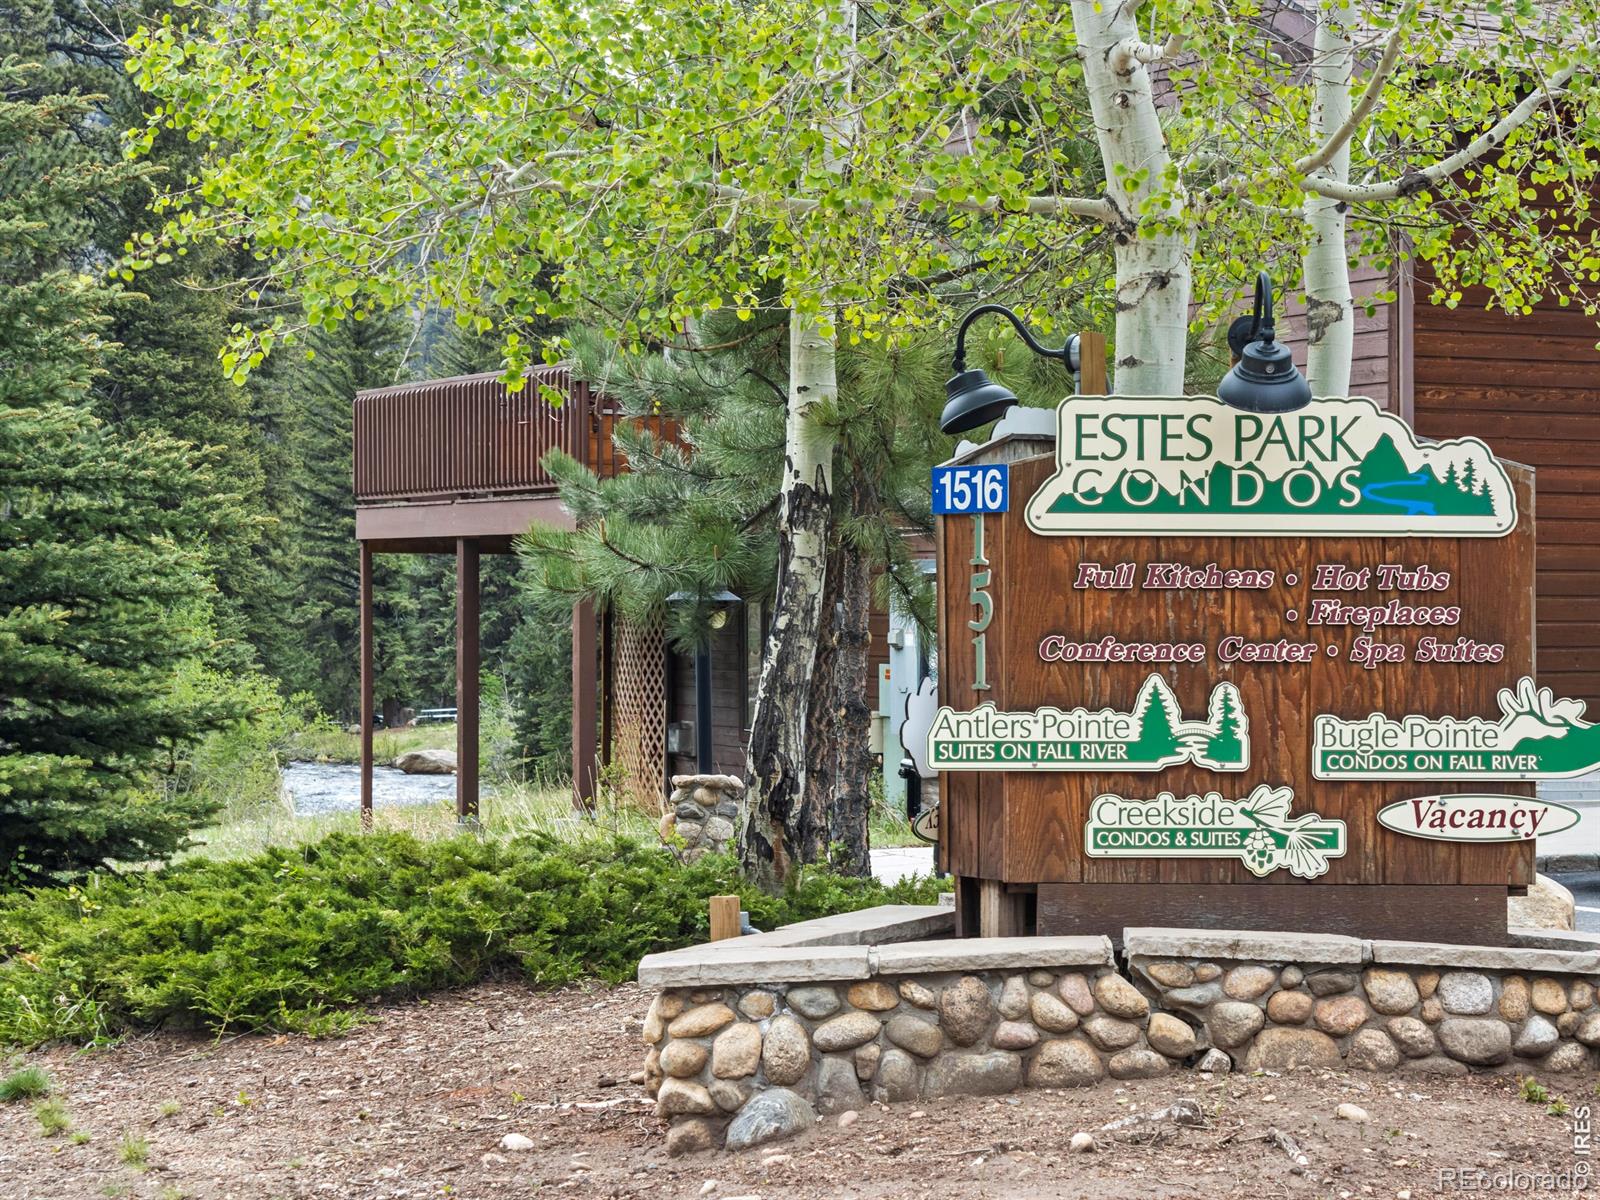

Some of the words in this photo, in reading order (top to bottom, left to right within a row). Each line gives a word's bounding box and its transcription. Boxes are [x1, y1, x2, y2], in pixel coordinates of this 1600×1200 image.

[1075, 413, 1213, 462] ESTES
[1233, 414, 1364, 463] PARK
[939, 468, 1003, 511] 1516
[1072, 468, 1363, 508] CONDOS
[1074, 563, 1136, 590] Full
[1143, 563, 1275, 589] Kitchens
[1312, 565, 1371, 591] Hot
[1376, 565, 1451, 591] Tubs
[1308, 599, 1461, 633] Fireplaces
[1039, 635, 1206, 663] Conference
[1218, 636, 1318, 663] Center
[1350, 636, 1406, 670] Spa
[1415, 636, 1505, 663] Suites
[934, 711, 1032, 739] Antlers
[1042, 714, 1130, 740] Pointe
[1321, 720, 1399, 756] Bugle
[1410, 723, 1499, 749] Pointe
[938, 743, 996, 761] SUITES
[1000, 743, 1032, 761] ON
[1037, 743, 1075, 760] FALL
[1080, 743, 1128, 760] RIVER
[1326, 754, 1408, 771] CONDOS
[1413, 754, 1443, 770] ON
[1450, 754, 1486, 770] FALL
[1491, 754, 1539, 770] RIVER
[1096, 799, 1235, 827] Creekside
[1411, 799, 1549, 839] Vacancy
[1096, 831, 1171, 847] CONDOS
[1174, 831, 1187, 847] &
[1190, 831, 1242, 847] SUITES
